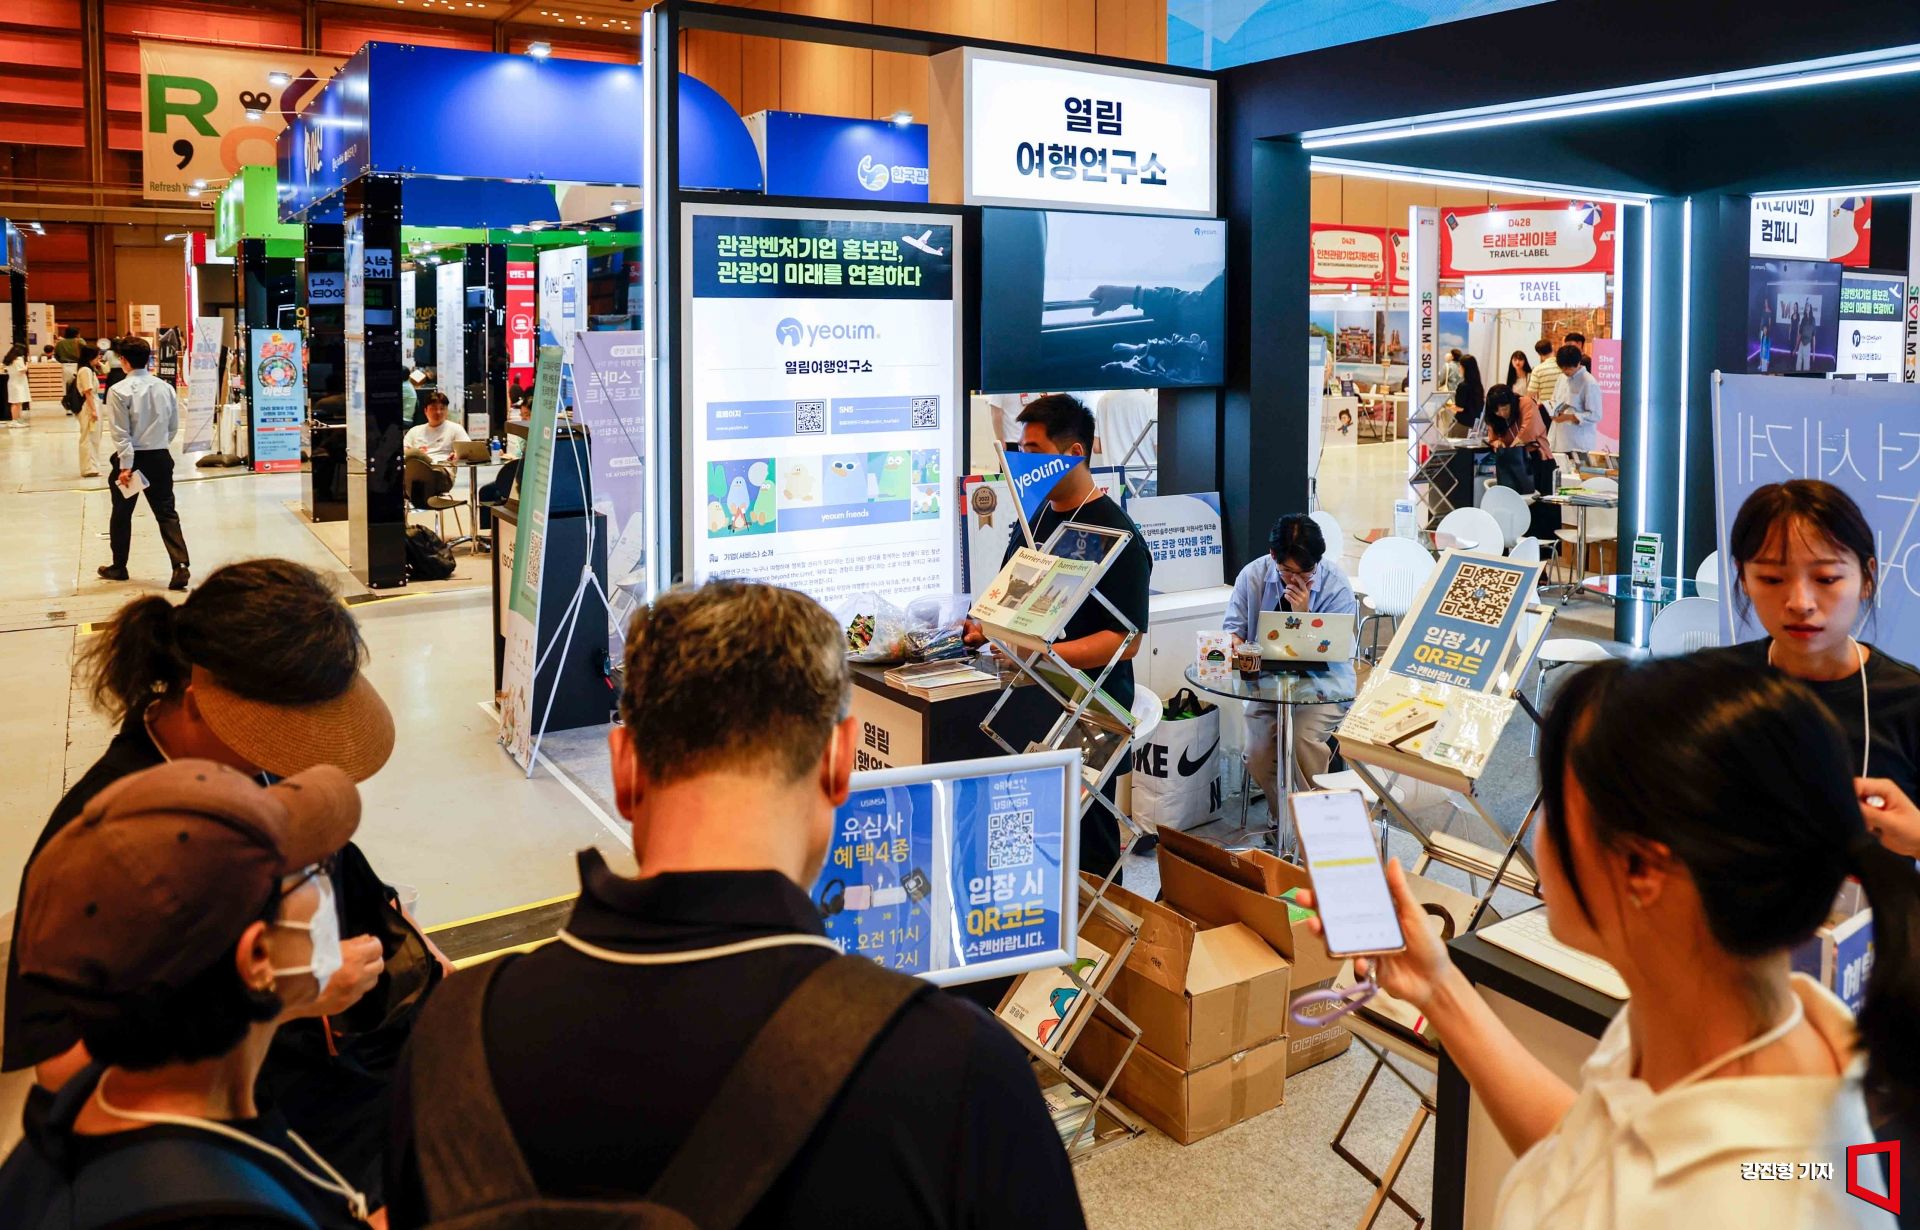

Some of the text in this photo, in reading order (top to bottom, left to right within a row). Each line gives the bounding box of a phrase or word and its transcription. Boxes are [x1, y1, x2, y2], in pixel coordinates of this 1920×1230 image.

[1064, 96, 1122, 136] 열림
[891, 166, 928, 185] 한국관
[1016, 141, 1167, 186] 여행연구소
[149, 181, 181, 193] Refresh
[1508, 217, 1531, 227] D428
[1761, 219, 1798, 244] 컴퍼니
[717, 235, 904, 263] 관광벤처기업 홍보관,
[1482, 231, 1557, 248] 트래블레이블
[1489, 248, 1550, 259] TRAVEL-LABEL
[717, 261, 921, 287] 관광의 미래를 연결하다
[1519, 281, 1561, 291] TRAVEL
[1528, 291, 1561, 302] LABEL
[785, 360, 873, 375] 열림여행연구소
[1598, 355, 1615, 363] She
[1014, 457, 1070, 498] yeolim.
[845, 508, 869, 520] friends
[1162, 538, 1176, 549] 관광
[1177, 536, 1198, 547] 약자를
[1200, 535, 1213, 545] 위한
[1169, 550, 1176, 559] 및
[1178, 548, 1192, 558] 여행
[1193, 546, 1207, 556] 상품
[1208, 545, 1222, 555] 개발
[1423, 626, 1491, 657] 입장 시
[1413, 644, 1483, 675] QR코드
[863, 721, 889, 756] 열림
[1132, 742, 1168, 778] KE
[860, 798, 886, 808] USIMSA
[841, 811, 904, 843] 유심사
[968, 868, 1044, 906] 입장 시
[966, 899, 1046, 937] QR코드
[855, 930, 884, 950] 오전
[889, 925, 920, 945] 11시
[965, 932, 1046, 959] 스캔바랍니다.
[894, 951, 919, 969] 2시
